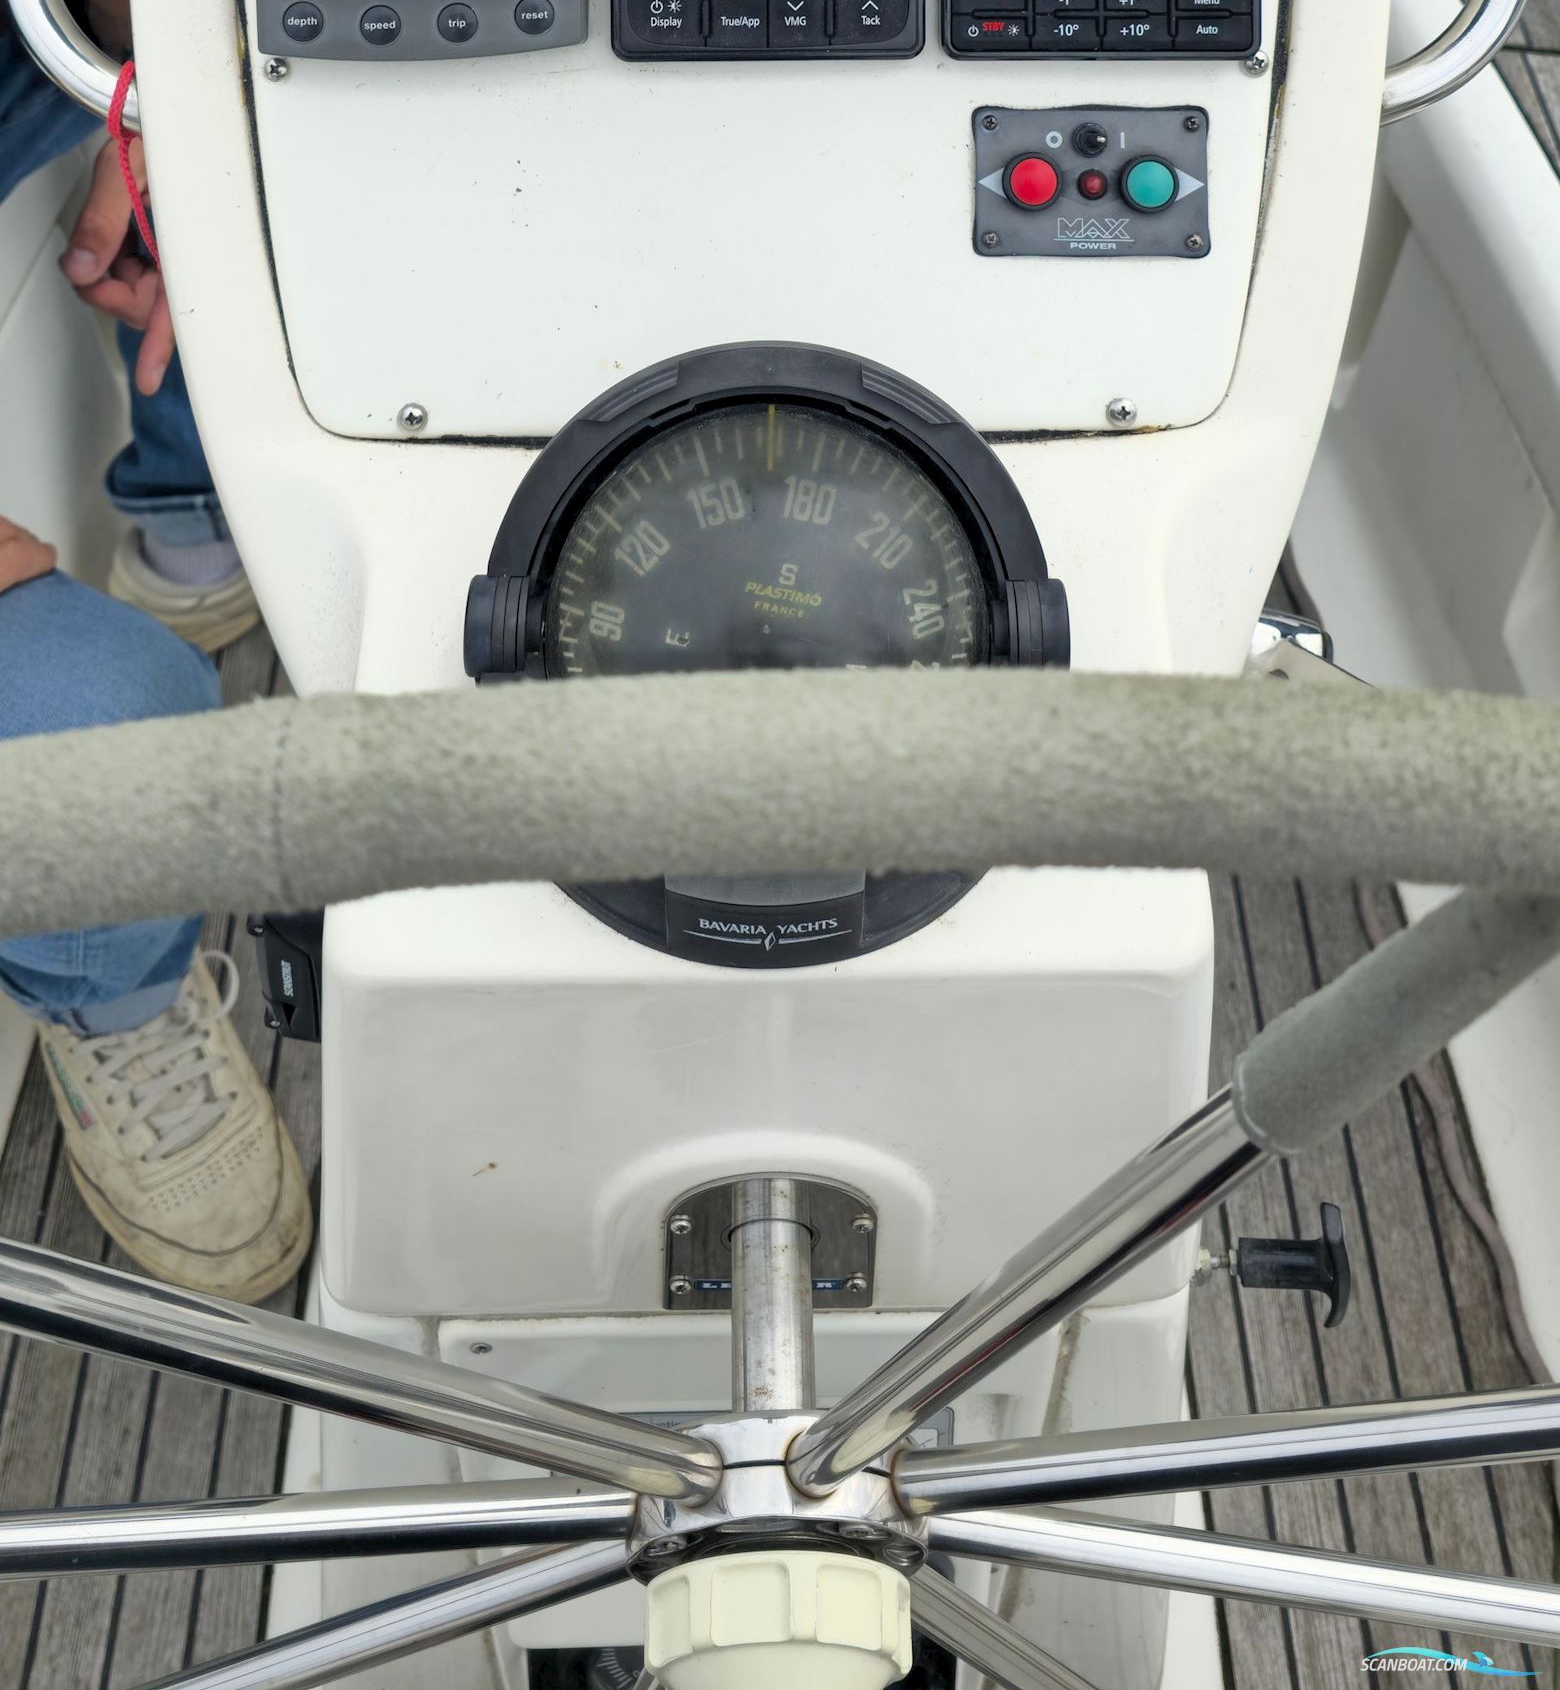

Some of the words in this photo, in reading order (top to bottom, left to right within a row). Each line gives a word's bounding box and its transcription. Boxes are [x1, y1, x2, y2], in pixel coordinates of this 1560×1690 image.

[287, 15, 318, 27] depth
[521, 10, 550, 20] reset
[784, 15, 807, 26] VMG
[861, 15, 881, 26] Tack
[364, 19, 396, 32] speed
[448, 18, 466, 30] trip
[650, 16, 682, 29] Display
[721, 16, 760, 28] True/App
[982, 21, 1005, 31] STBY
[1053, 24, 1079, 36] -10°
[1119, 24, 1150, 36] +10°
[1196, 24, 1218, 35] Auto
[1057, 217, 1130, 239] MAX
[1070, 242, 1117, 250] POWER
[686, 478, 745, 529] 150
[784, 475, 837, 525] 180
[854, 512, 913, 570] 210
[614, 519, 671, 577] 120
[779, 563, 798, 585] S
[745, 581, 822, 606] PLASTIMO
[754, 600, 804, 618] FRANCE
[903, 579, 945, 640] 240
[589, 600, 625, 642] 90
[665, 628, 690, 647] E
[699, 918, 768, 935] BAVARIA
[776, 918, 839, 935] YACHTS
